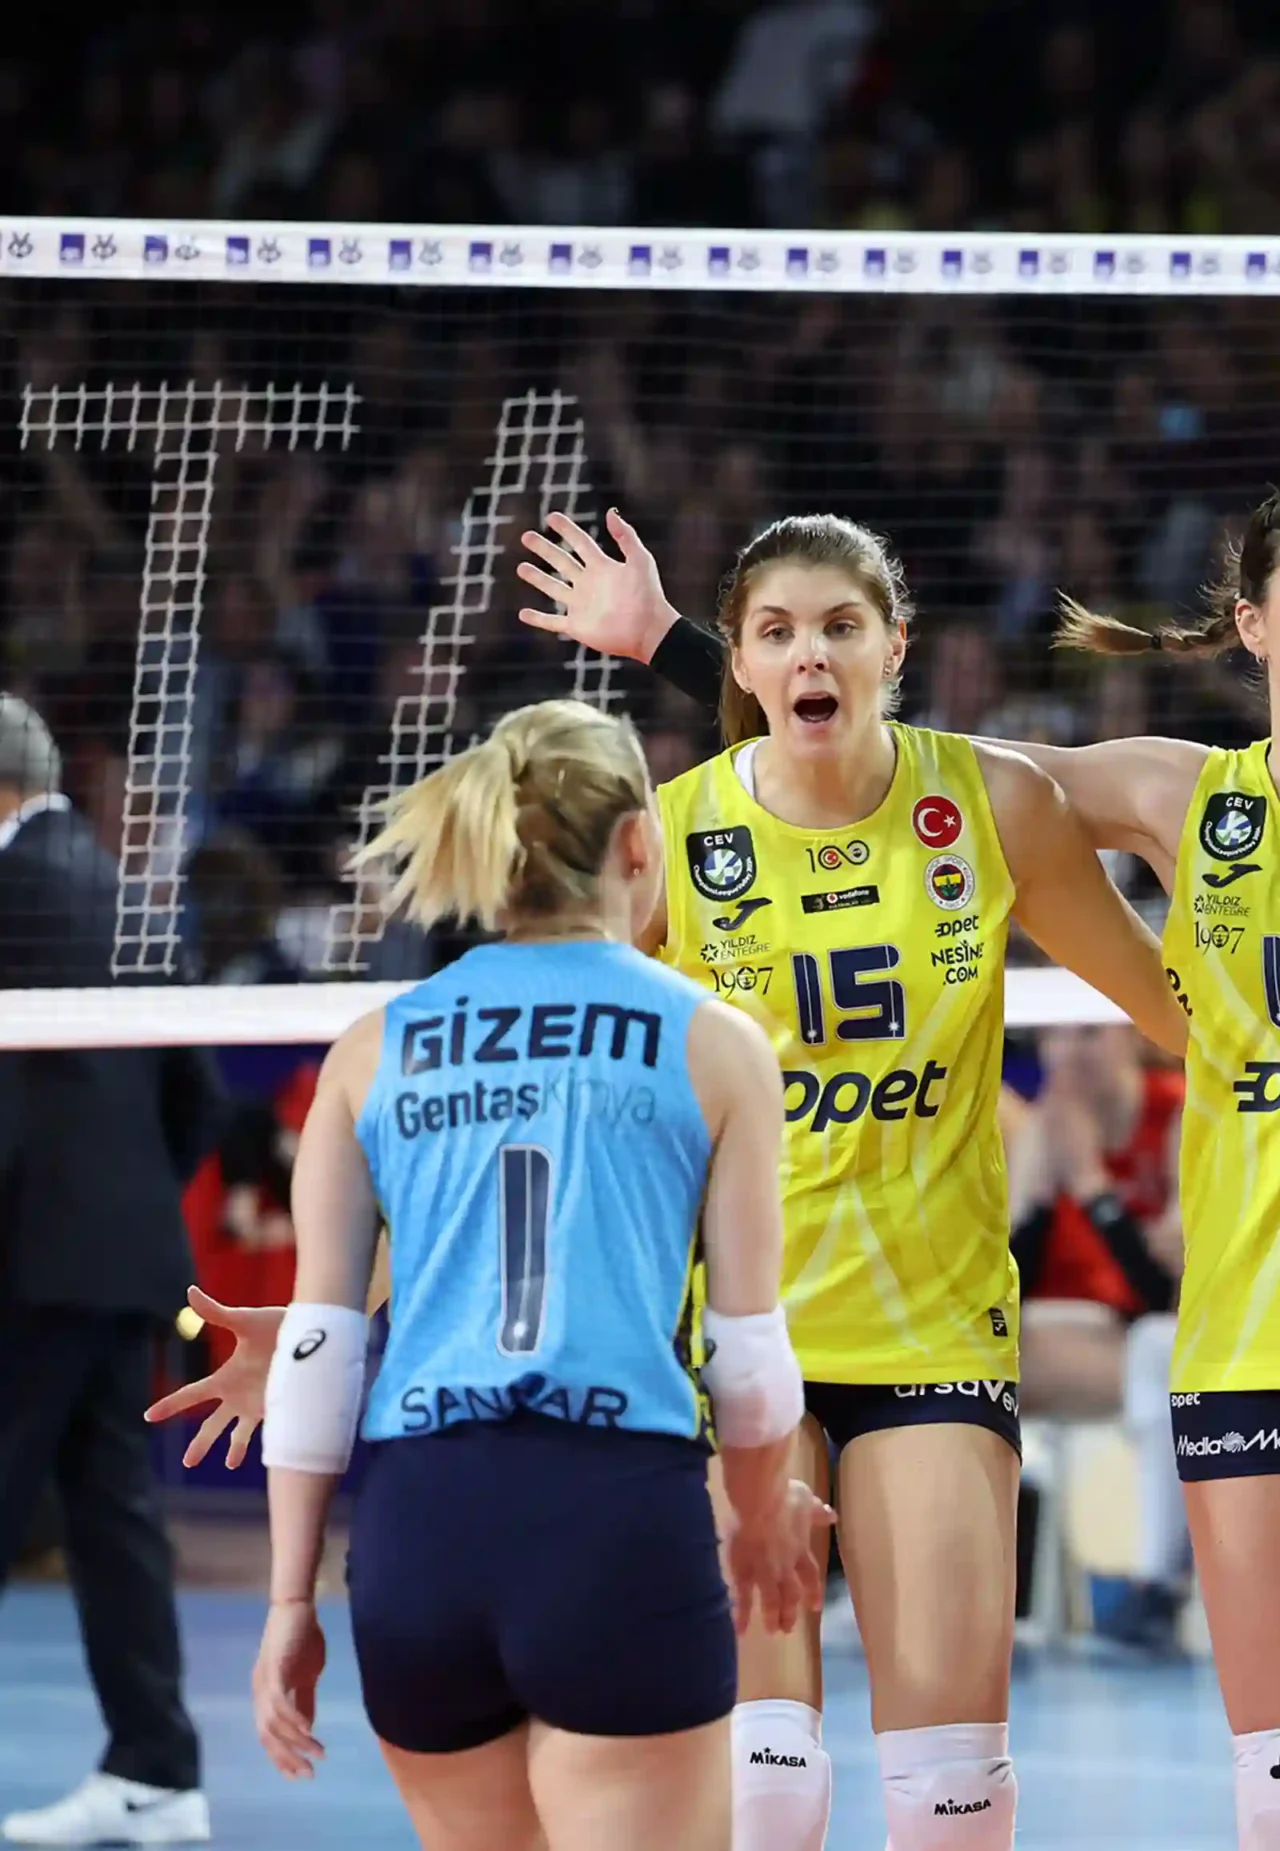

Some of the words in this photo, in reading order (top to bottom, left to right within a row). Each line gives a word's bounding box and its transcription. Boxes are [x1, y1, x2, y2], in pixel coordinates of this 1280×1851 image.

[1225, 796, 1254, 810] CEV
[703, 832, 734, 847] CEV
[935, 914, 980, 938] opet
[720, 934, 758, 950] YILDIZ
[1193, 920, 1246, 957] 1907
[720, 942, 773, 961] ENTEGRE
[708, 965, 774, 1001] 1907
[943, 965, 979, 986] .COM
[791, 943, 908, 1046] 15
[498, 1142, 554, 1359] 1
[401, 1372, 629, 1433] SANAR
